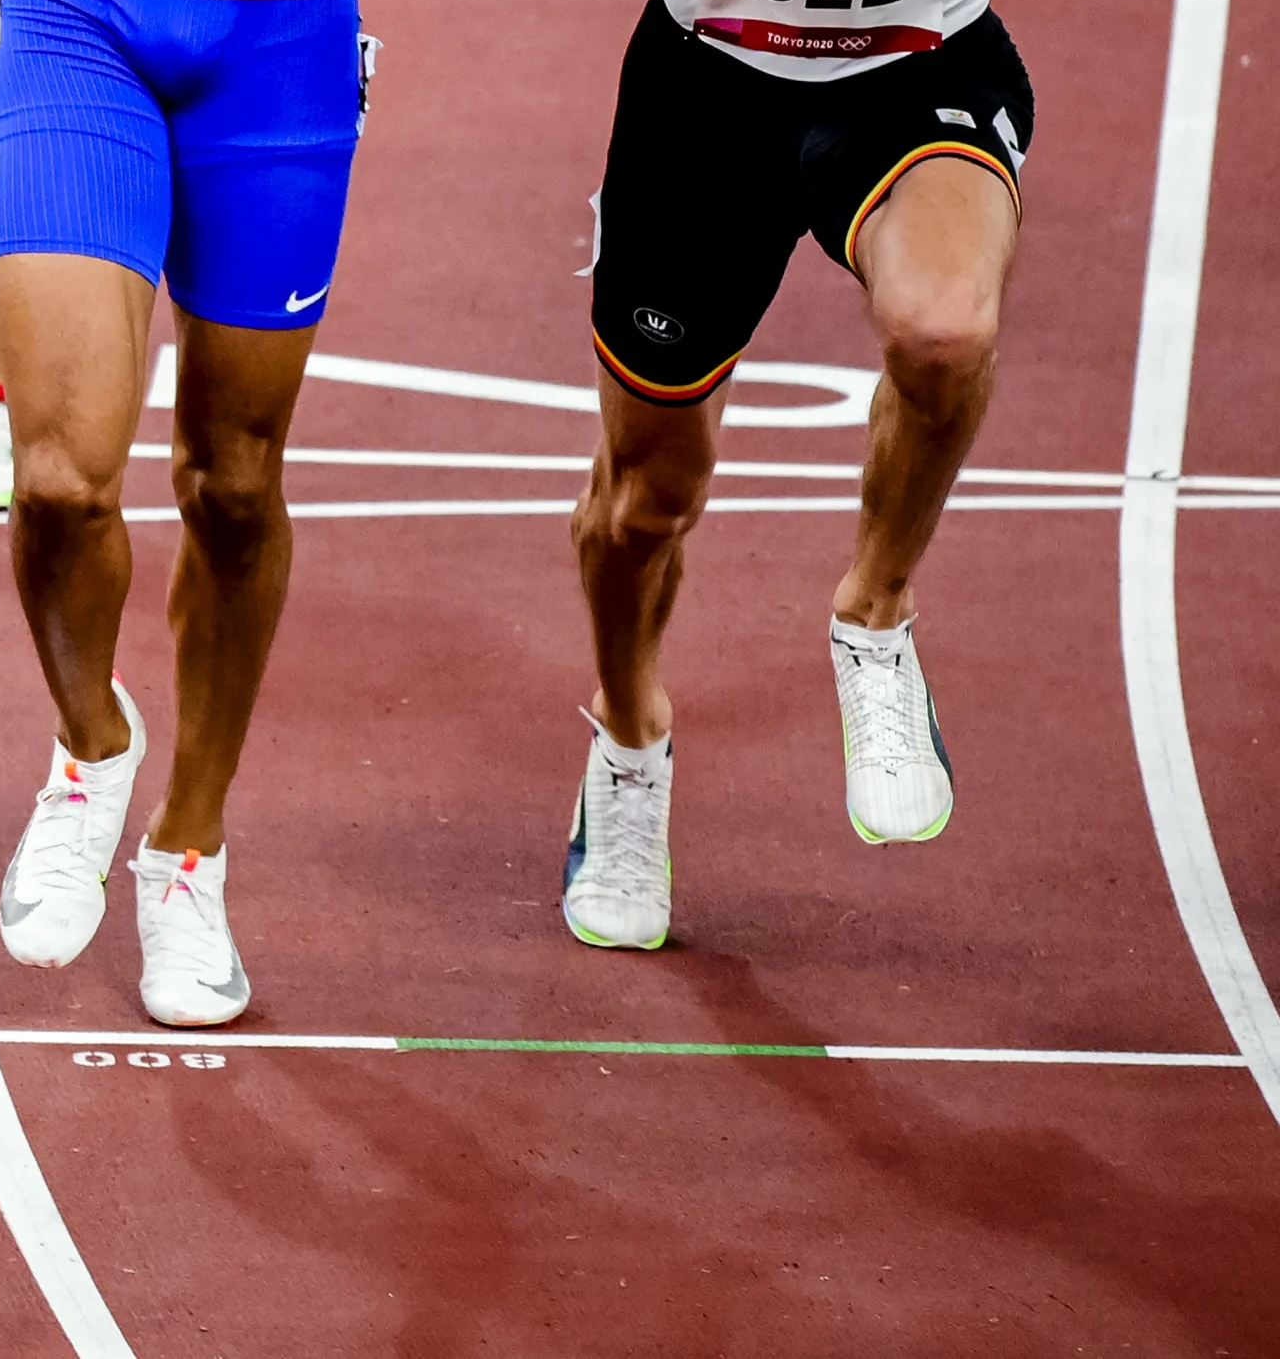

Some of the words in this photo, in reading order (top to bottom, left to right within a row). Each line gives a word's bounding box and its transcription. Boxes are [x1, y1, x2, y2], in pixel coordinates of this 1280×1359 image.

[766, 32, 804, 48] TOKYO
[805, 38, 834, 49] 2020
[71, 1051, 227, 1070] 800
